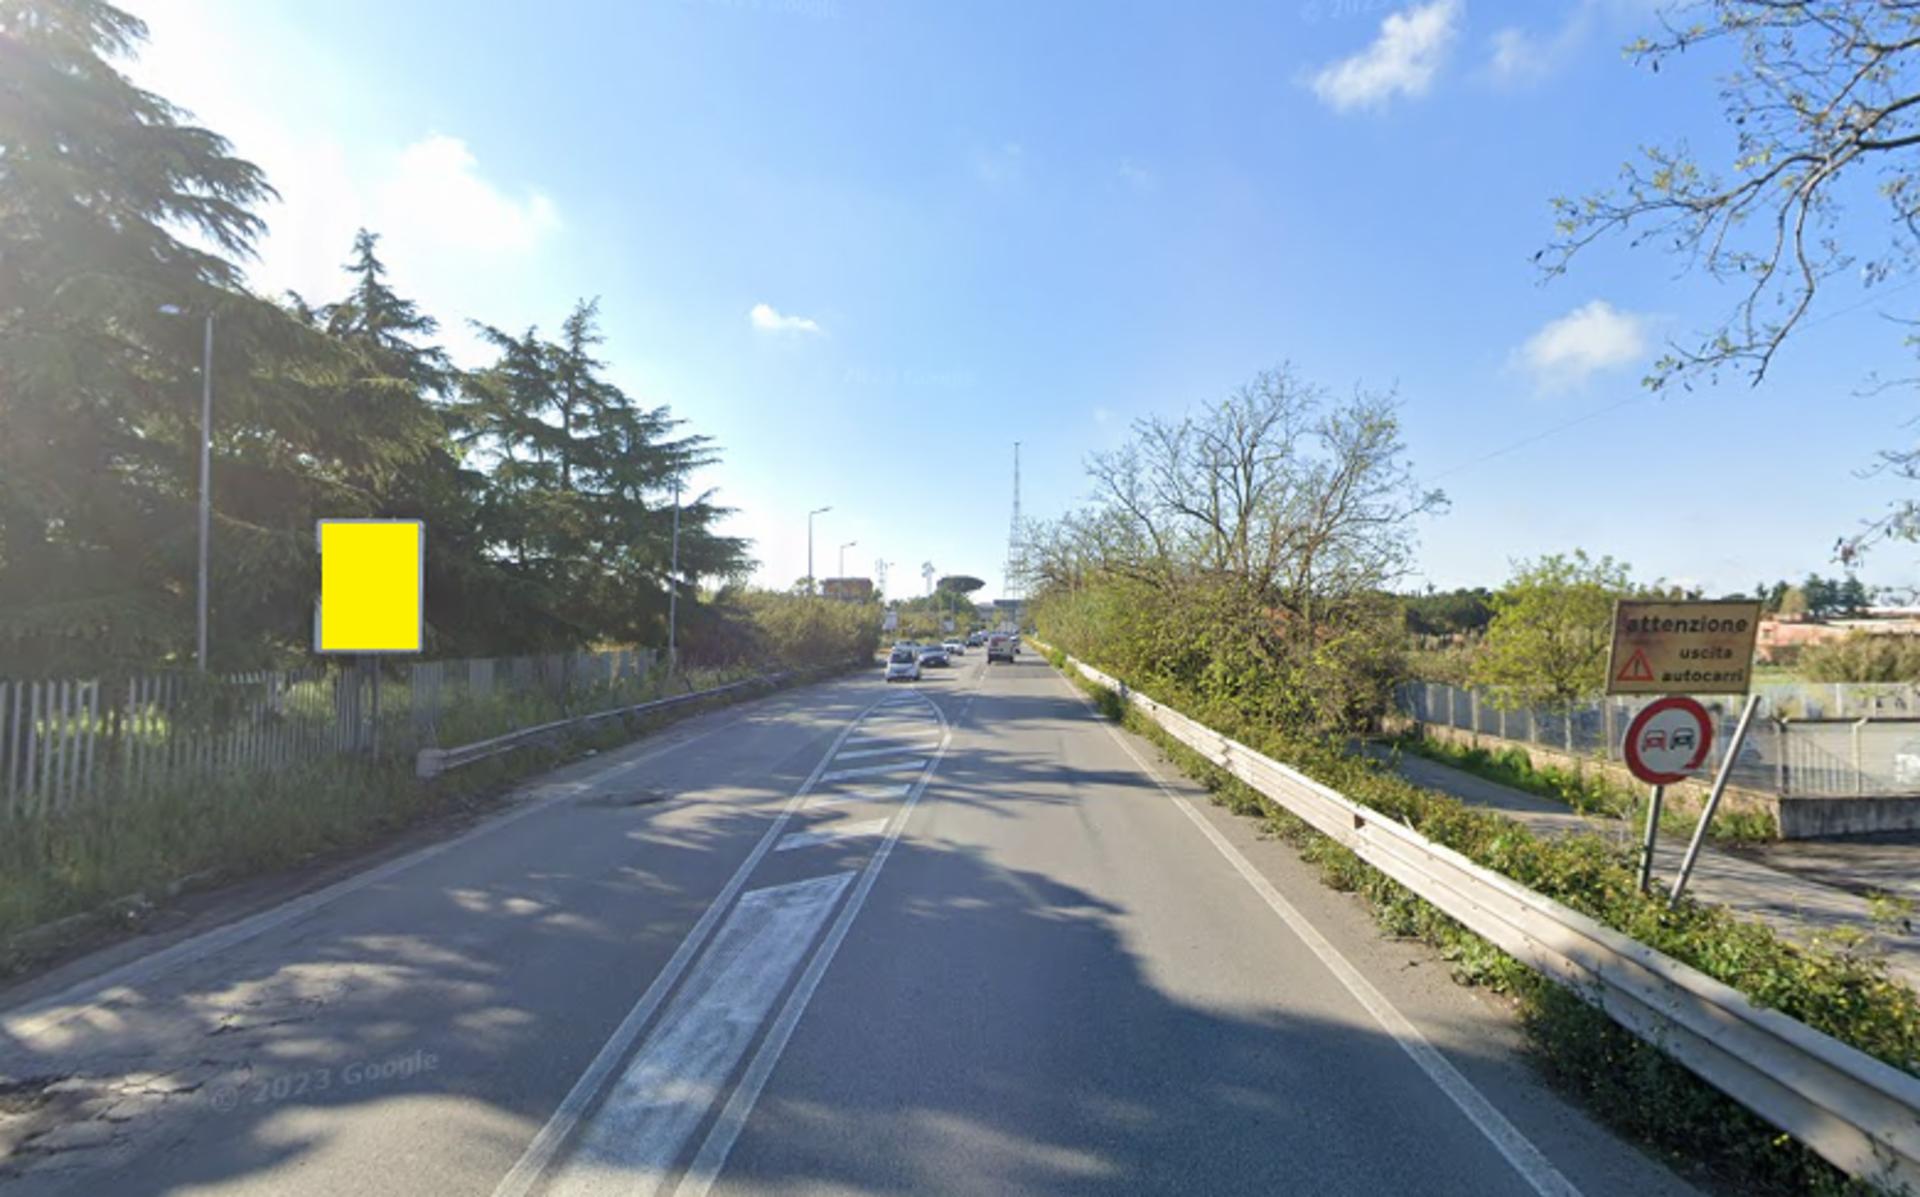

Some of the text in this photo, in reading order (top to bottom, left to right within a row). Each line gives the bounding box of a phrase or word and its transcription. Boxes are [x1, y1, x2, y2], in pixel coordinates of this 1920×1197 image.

[1626, 614, 1748, 633] attenzione
[1679, 646, 1733, 660] uscita
[1661, 669, 1743, 683] autocarri
